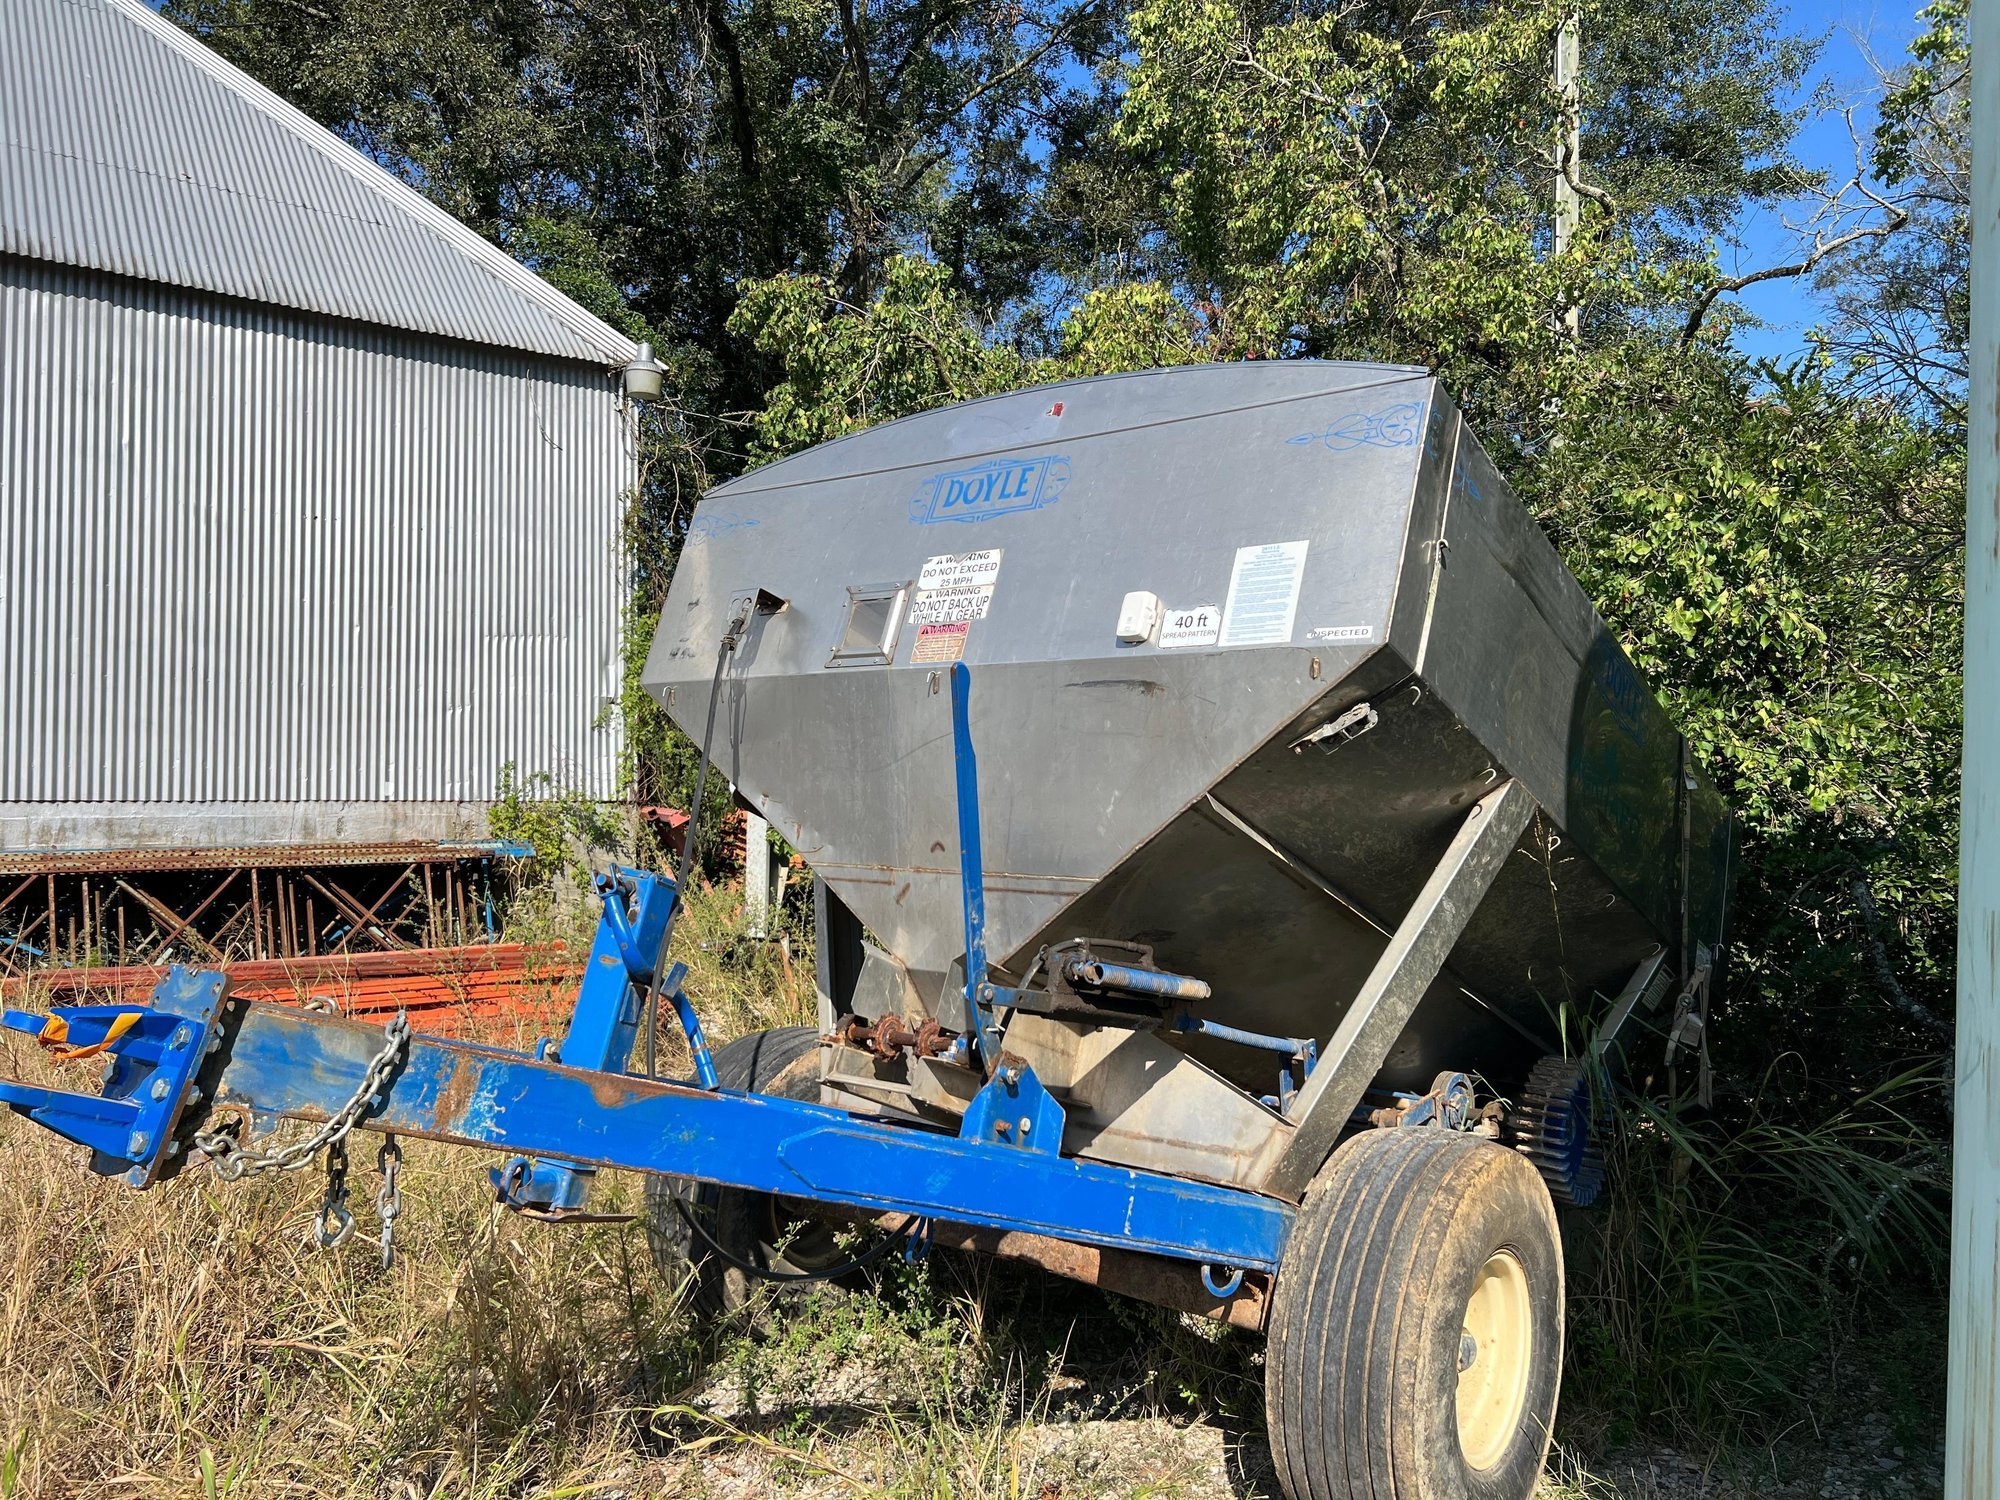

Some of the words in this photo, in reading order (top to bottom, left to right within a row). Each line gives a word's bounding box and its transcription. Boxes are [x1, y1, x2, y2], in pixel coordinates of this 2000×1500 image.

[943, 466, 1034, 508] DOYLE
[945, 552, 990, 563] WNING
[922, 568, 937, 577] DO
[938, 566, 958, 576] NOT
[960, 563, 998, 573] EXCEED
[940, 578, 951, 587] 25
[952, 576, 973, 586] MPH
[936, 587, 981, 598] WARNING
[913, 601, 926, 612] DO
[926, 600, 947, 611] NOT
[948, 597, 975, 610] BACK
[976, 596, 990, 608] UP
[914, 611, 941, 624] WHILE
[943, 610, 954, 622] IN
[956, 608, 983, 621] GEAR
[1175, 615, 1194, 629] 40
[1196, 613, 1209, 627] ft
[930, 624, 967, 634] WARNING
[1162, 631, 1187, 640] SPREAD
[1187, 629, 1217, 638] PATTERN
